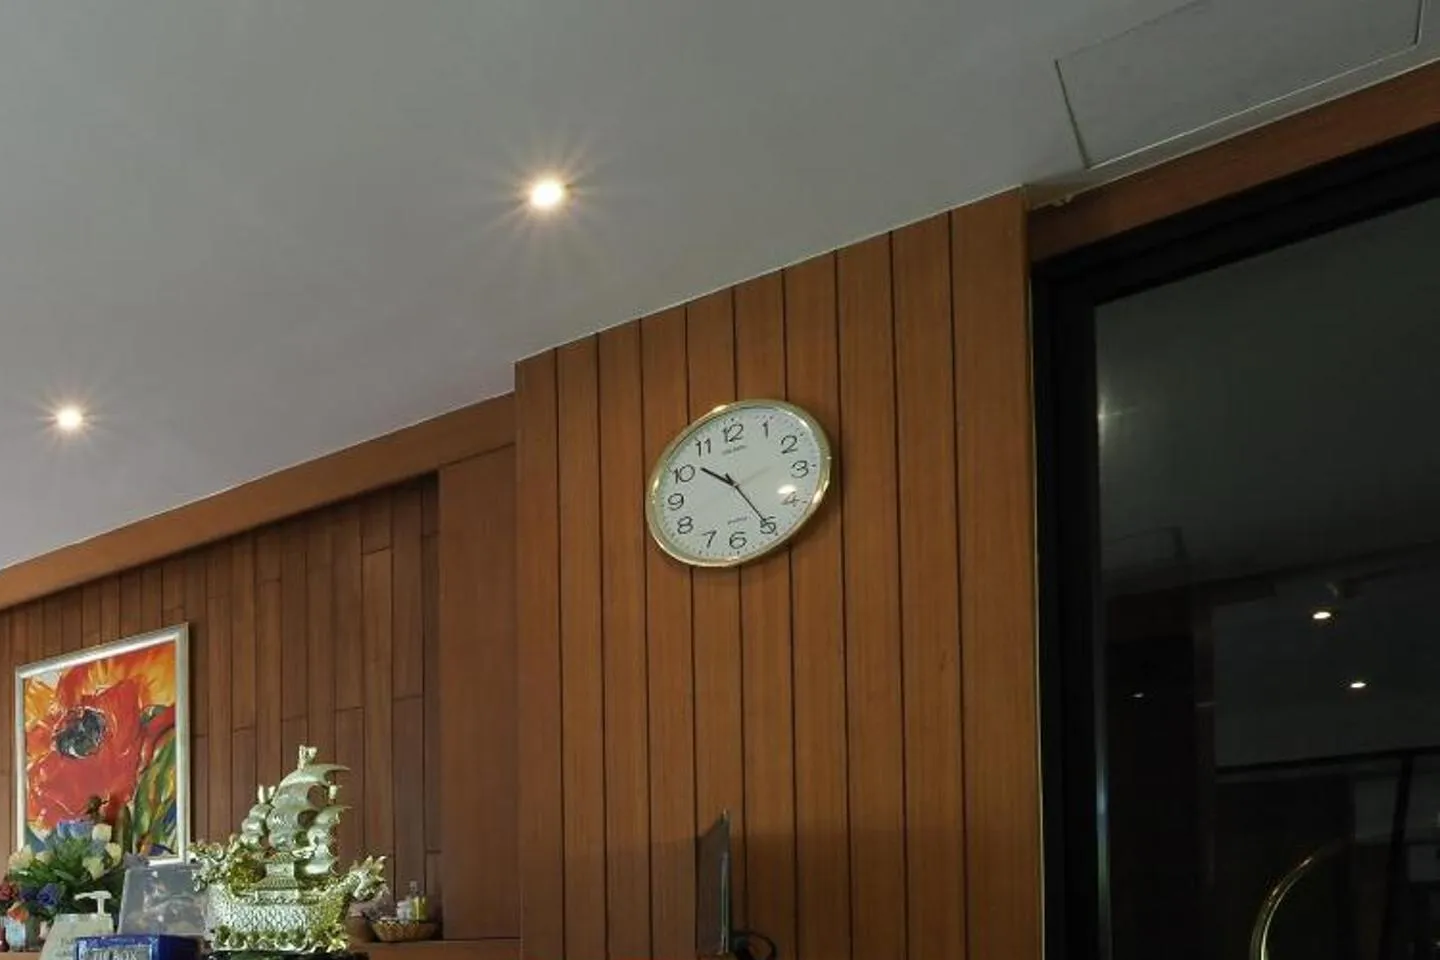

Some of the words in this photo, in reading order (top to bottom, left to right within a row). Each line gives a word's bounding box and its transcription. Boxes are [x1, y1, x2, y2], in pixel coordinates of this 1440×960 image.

[722, 423, 744, 443] 12
[762, 421, 769, 438] 1
[695, 438, 712, 457] 11
[781, 434, 798, 453] 2
[673, 464, 695, 484] 10
[791, 460, 809, 478] 3
[667, 493, 684, 511] 9
[780, 491, 800, 508] 4
[677, 516, 693, 535] 8
[760, 516, 776, 534] 5
[702, 530, 717, 548] 7
[729, 532, 747, 549] 6
